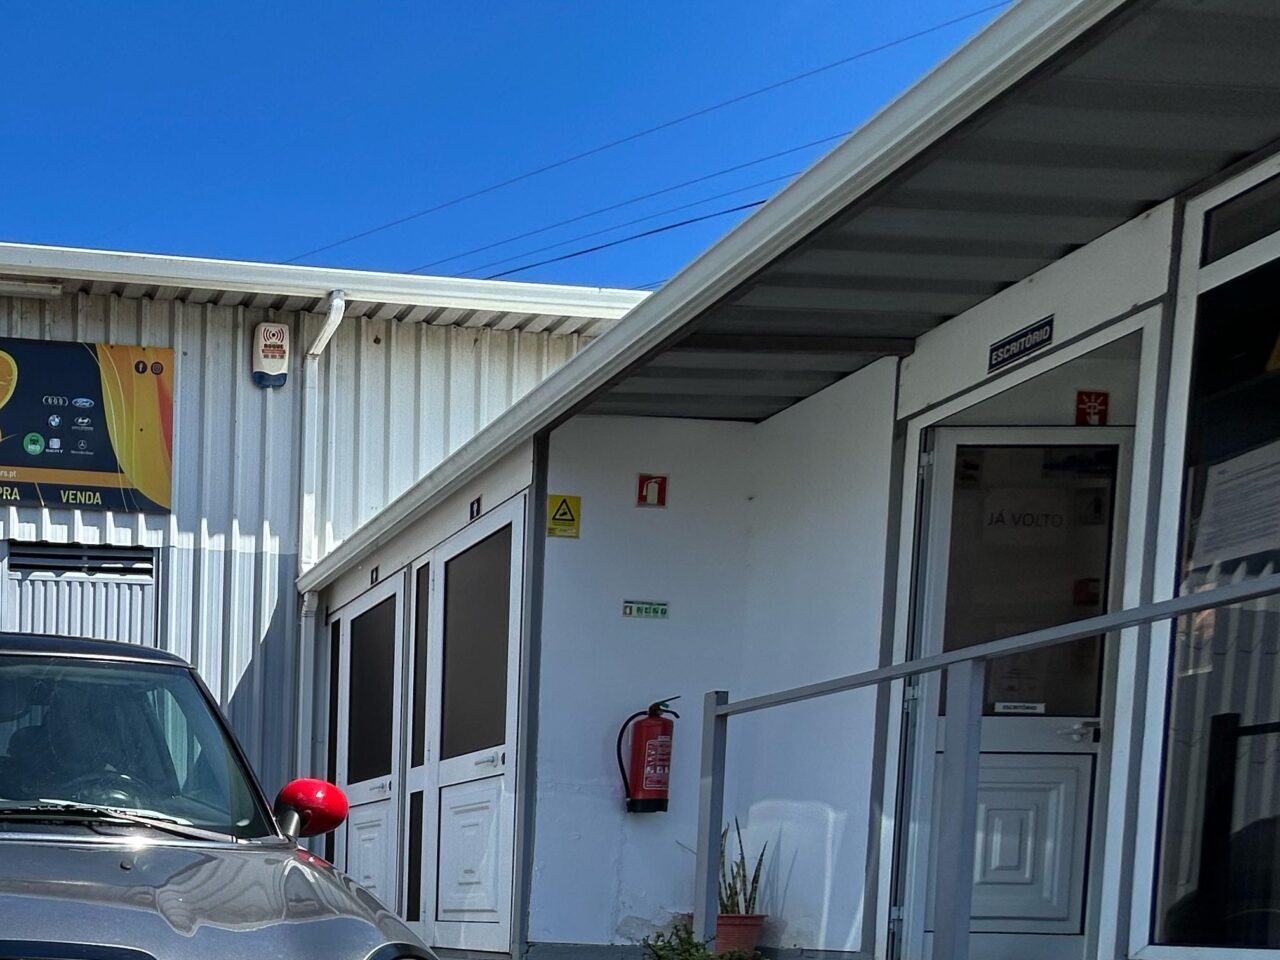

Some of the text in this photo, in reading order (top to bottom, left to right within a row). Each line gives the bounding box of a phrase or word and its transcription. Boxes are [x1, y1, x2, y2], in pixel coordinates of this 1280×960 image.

[991, 325, 1051, 364] ESCRITÓRIO
[60, 490, 102, 504] VENDA
[988, 509, 1063, 528] JÁ VOLTO
